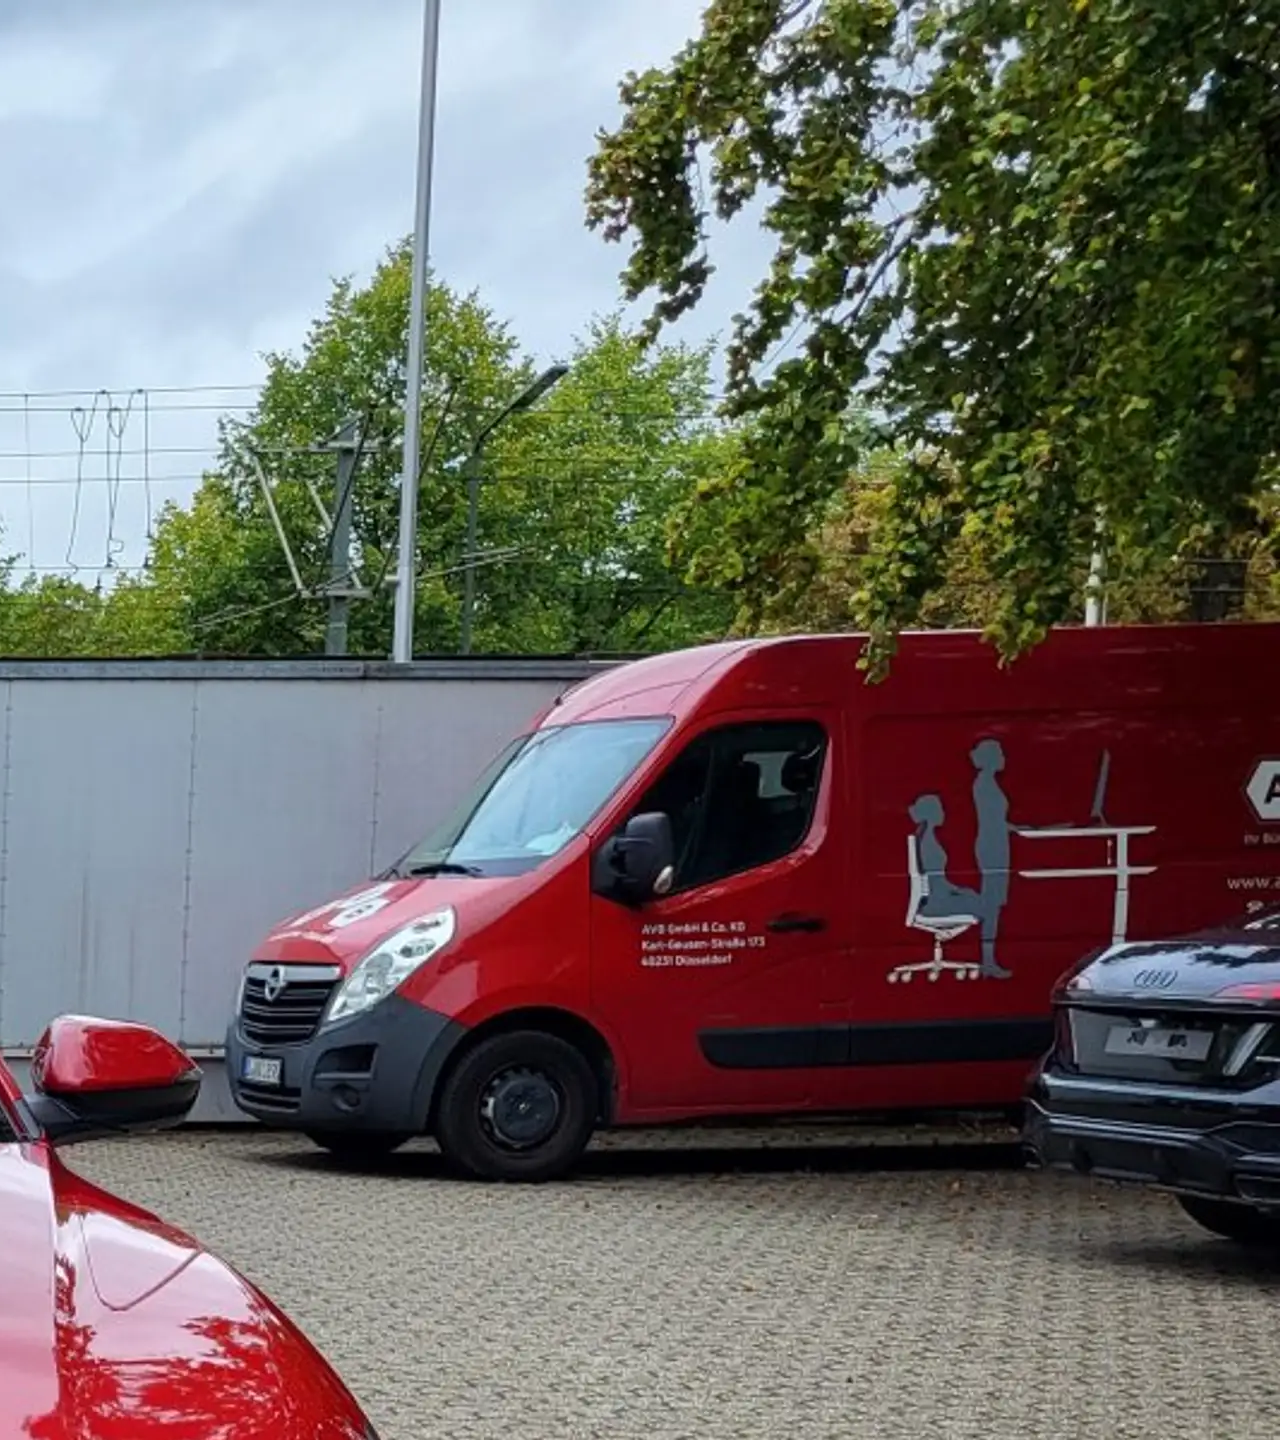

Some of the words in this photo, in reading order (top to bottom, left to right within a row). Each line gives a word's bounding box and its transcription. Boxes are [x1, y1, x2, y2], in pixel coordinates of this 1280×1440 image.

[667, 922, 700, 934] GmbH
[701, 921, 709, 933] &
[711, 921, 728, 933] Co.
